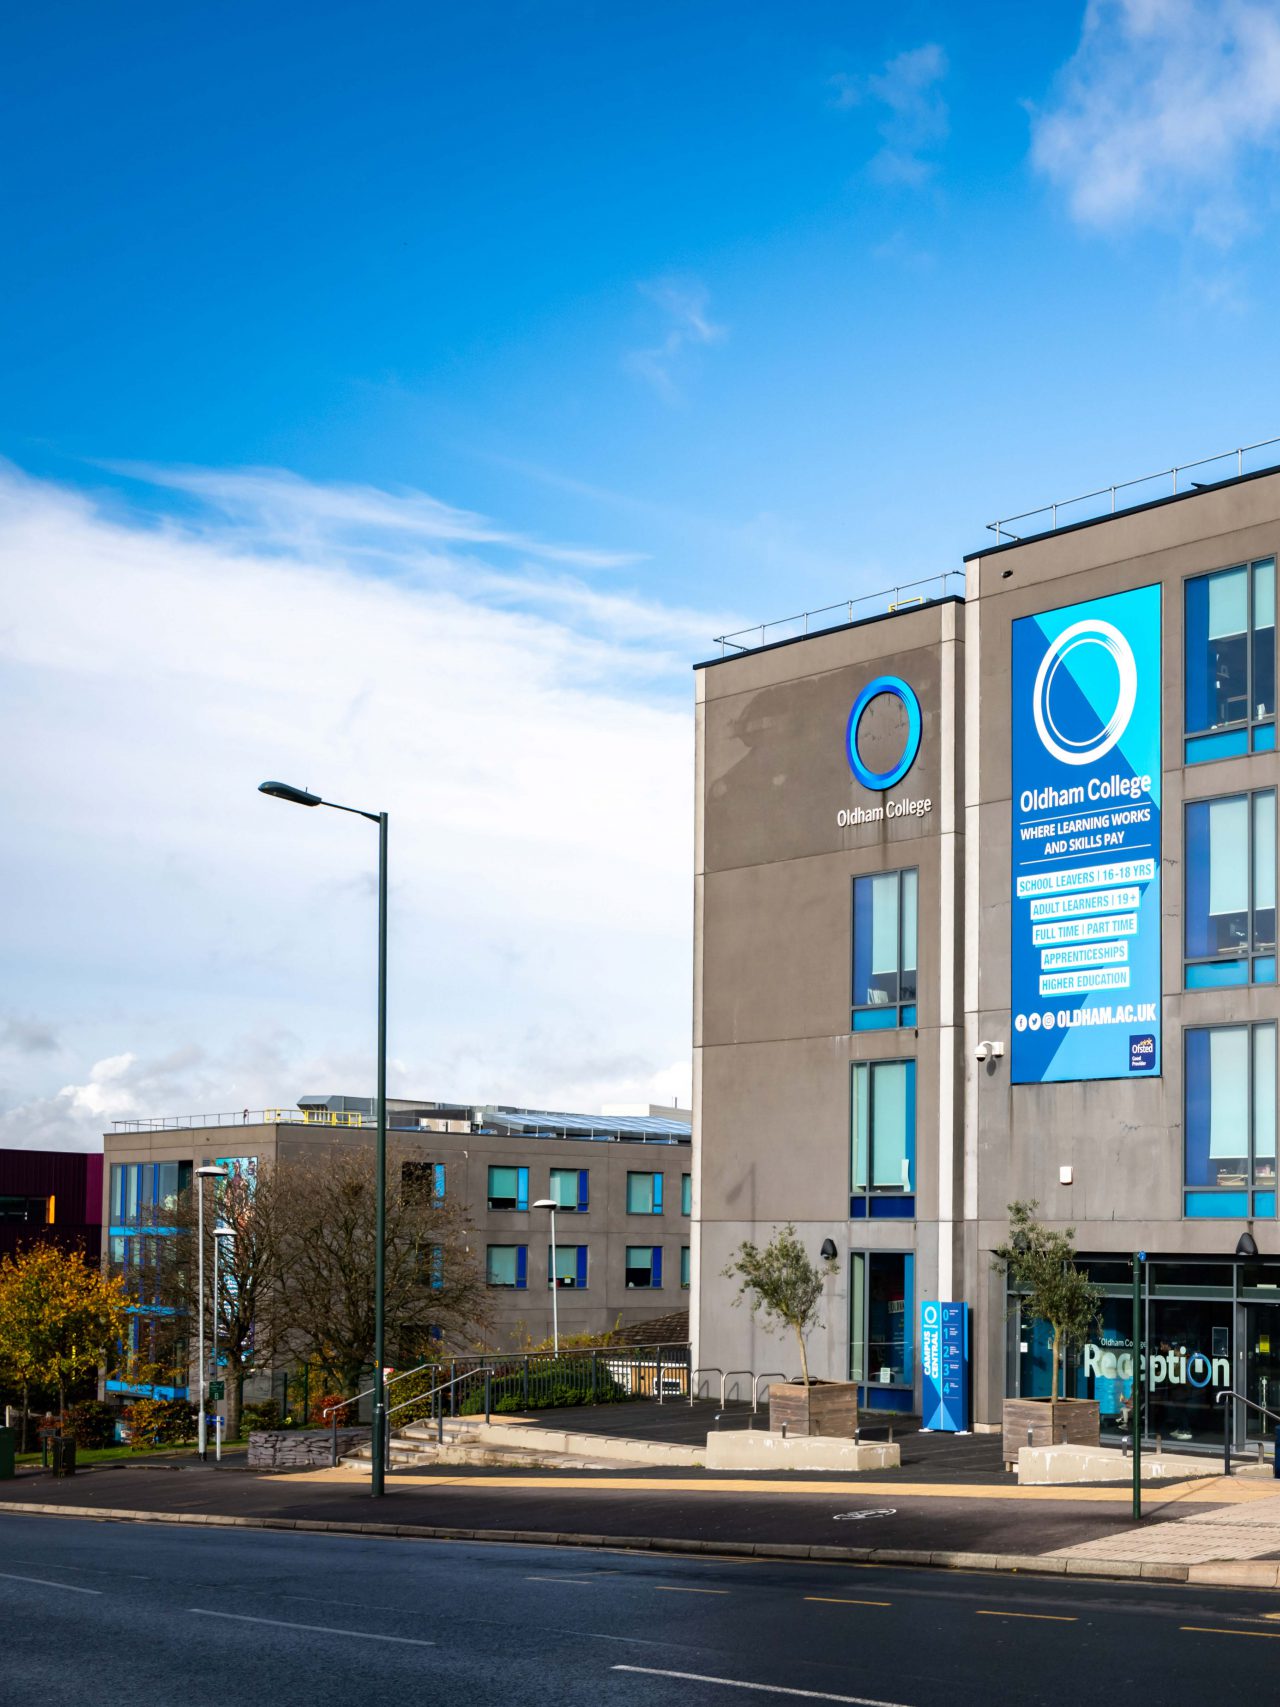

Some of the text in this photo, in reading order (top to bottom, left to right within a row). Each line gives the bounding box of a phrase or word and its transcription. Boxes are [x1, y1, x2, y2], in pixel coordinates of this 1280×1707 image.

[1020, 774, 1151, 812] Oldham College
[837, 798, 932, 827] Oldham College
[1020, 809, 1151, 840] WHERE LEARNING WORKS
[1044, 831, 1125, 855] AND SKILLS PAY
[1019, 877, 1053, 892] SCHOOL
[1055, 871, 1094, 887] LEAVERS
[1103, 866, 1131, 879] 16-18
[1133, 863, 1151, 876] YRS
[1033, 902, 1060, 916] ADULT
[1062, 895, 1109, 912] LEARNERS
[1035, 925, 1056, 941] FULL
[1058, 923, 1080, 938] TIME
[1087, 921, 1110, 935] PART
[1111, 918, 1134, 931] TIME
[1044, 946, 1125, 965] APPRENTICESHIPS
[1042, 972, 1127, 990] HIGHER EDUCATION
[1057, 1003, 1157, 1028] OLDHAM.AC.UK
[1131, 1043, 1153, 1054] Ofsted
[943, 1309, 949, 1321] 0
[943, 1328, 949, 1340] 1
[1100, 1337, 1148, 1349] Oldham Coge
[931, 1331, 939, 1379] CENTRAL
[943, 1346, 949, 1358] 2
[943, 1364, 950, 1376] 3
[943, 1382, 950, 1395] 4
